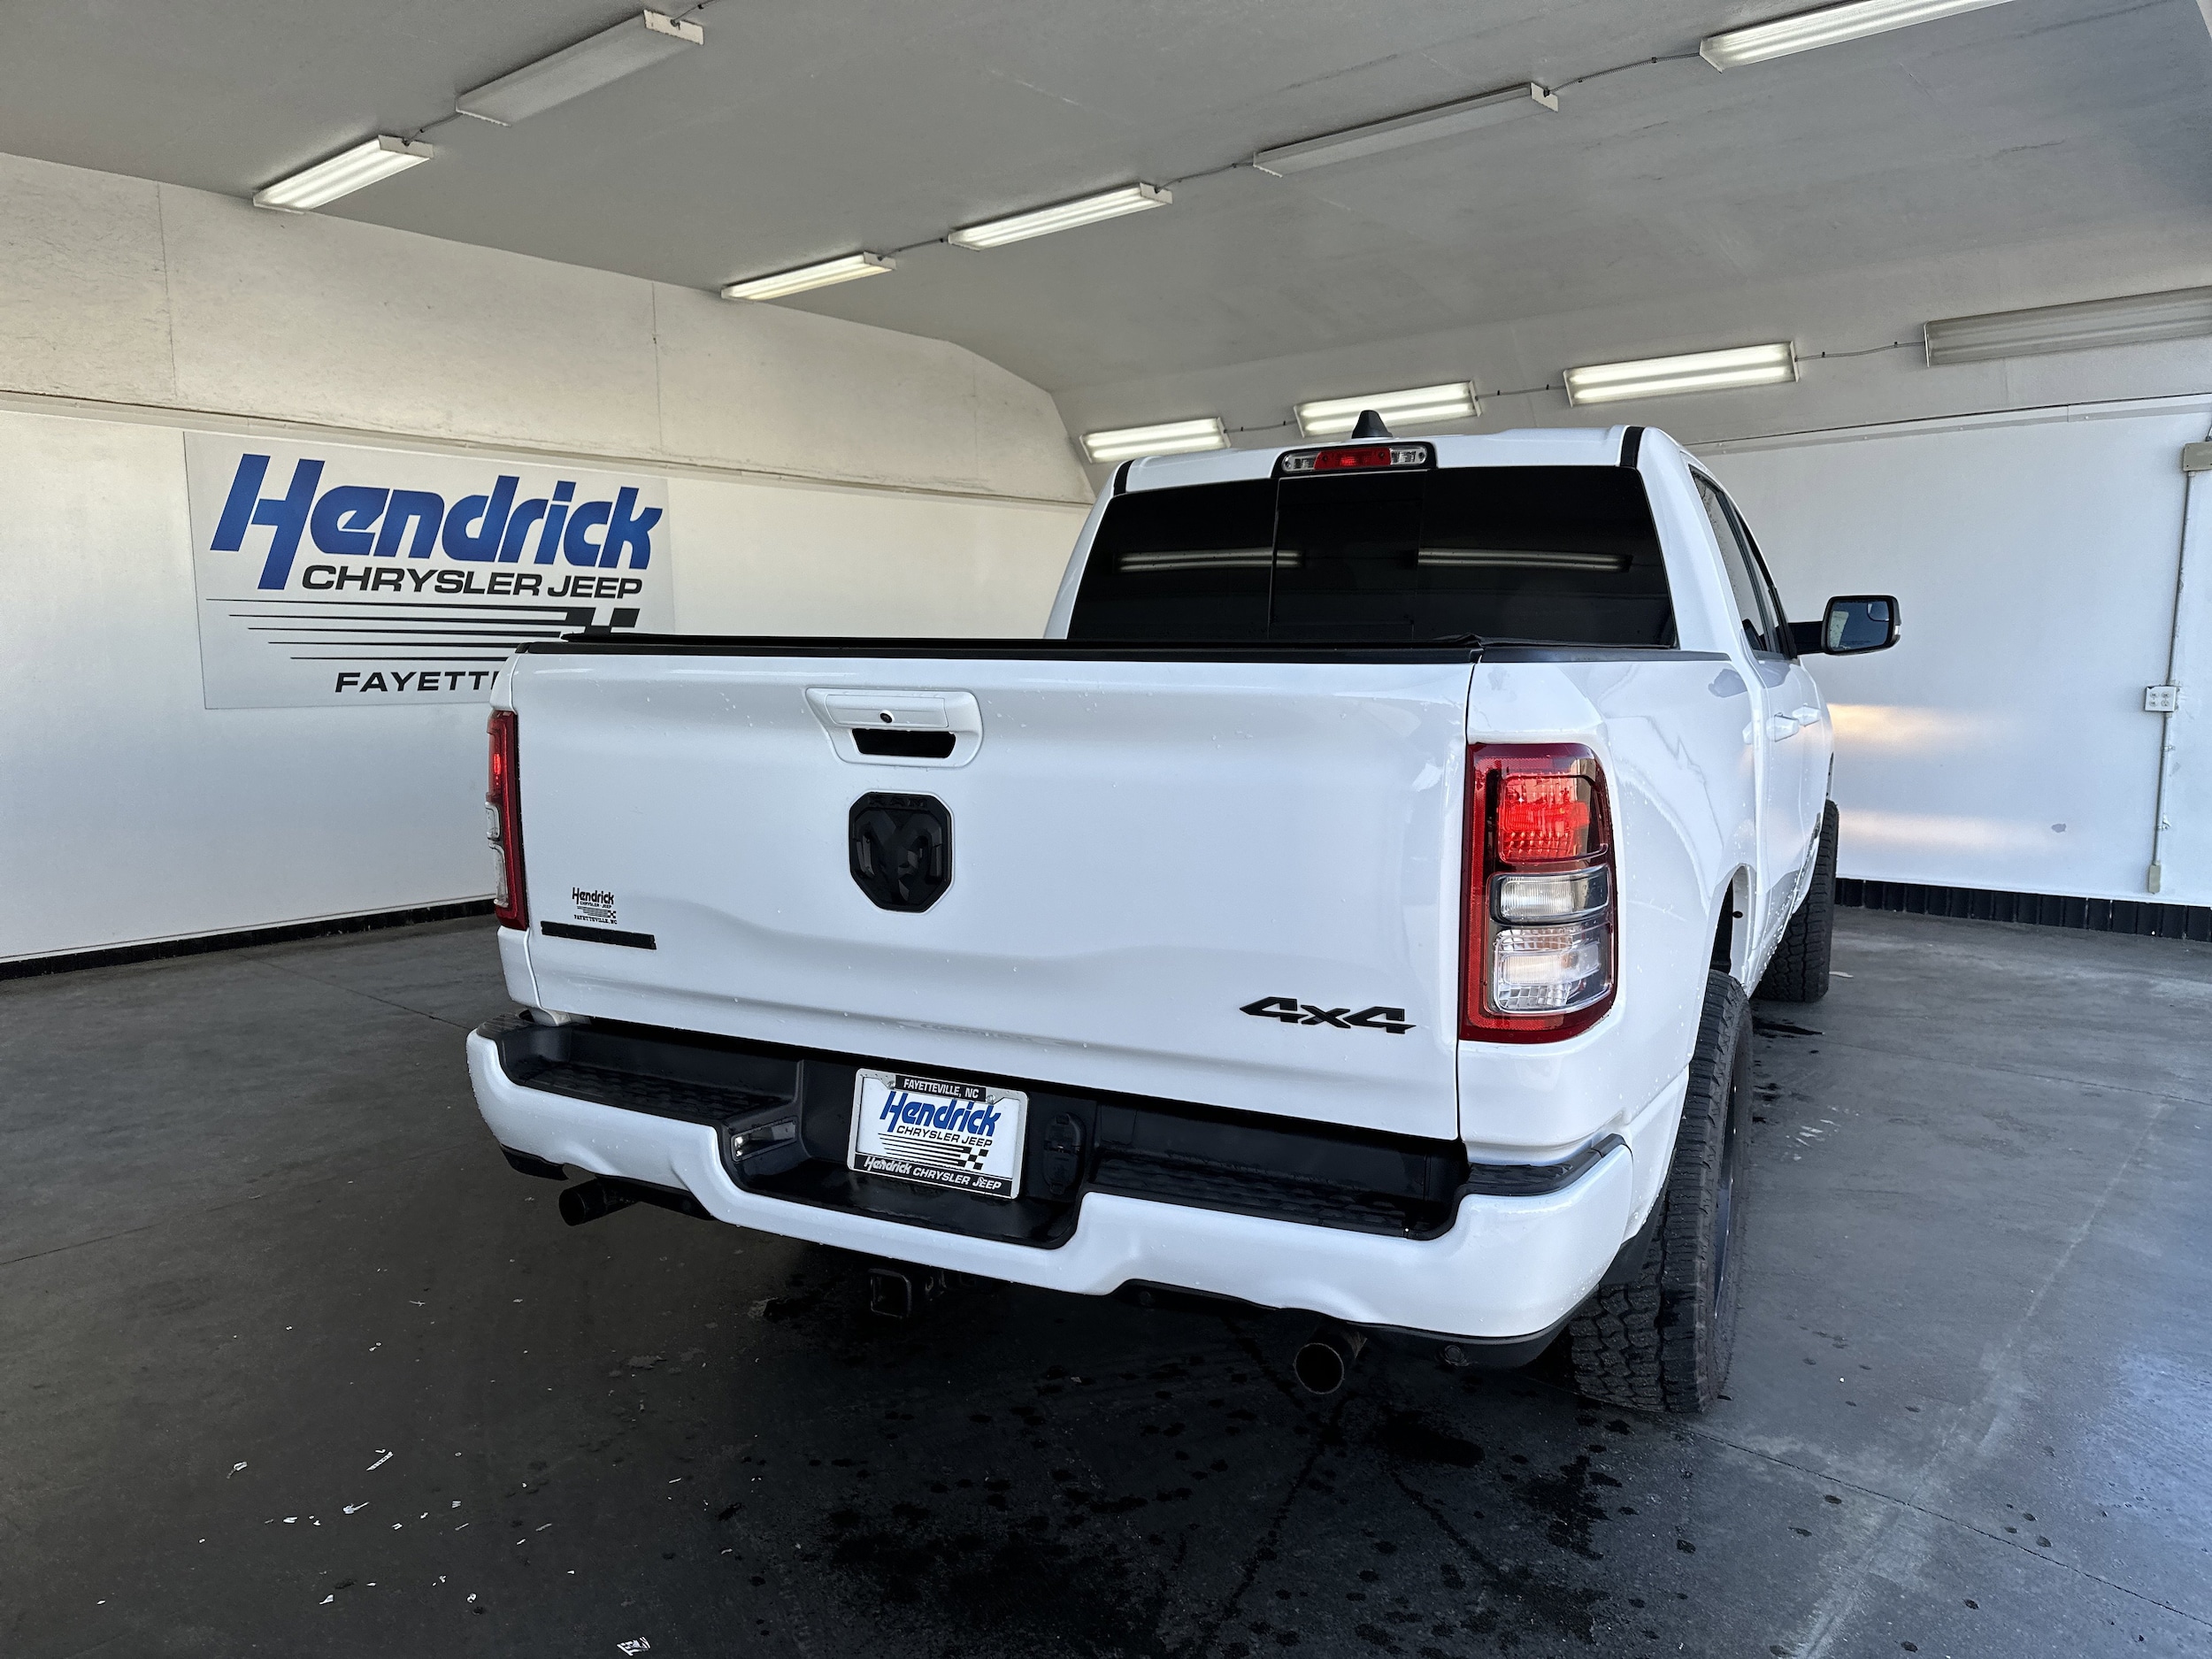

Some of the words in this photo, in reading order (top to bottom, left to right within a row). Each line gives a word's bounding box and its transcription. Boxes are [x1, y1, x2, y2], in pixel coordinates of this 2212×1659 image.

[210, 454, 663, 589] Hendrick
[302, 565, 542, 595] CHRYSLER
[547, 575, 643, 599] JEEP
[572, 887, 614, 904] Hendrick
[903, 1079, 962, 1097] FAYETTEVILLE,
[964, 1087, 979, 1099] NC
[879, 1091, 1002, 1137] Hendrick
[896, 1125, 960, 1142] CHRYSLER
[961, 1137, 994, 1148] JEEP
[864, 1156, 913, 1172] Hendrick
[912, 1167, 971, 1185] CHRYSLER
[972, 1178, 1002, 1190] JEEP
